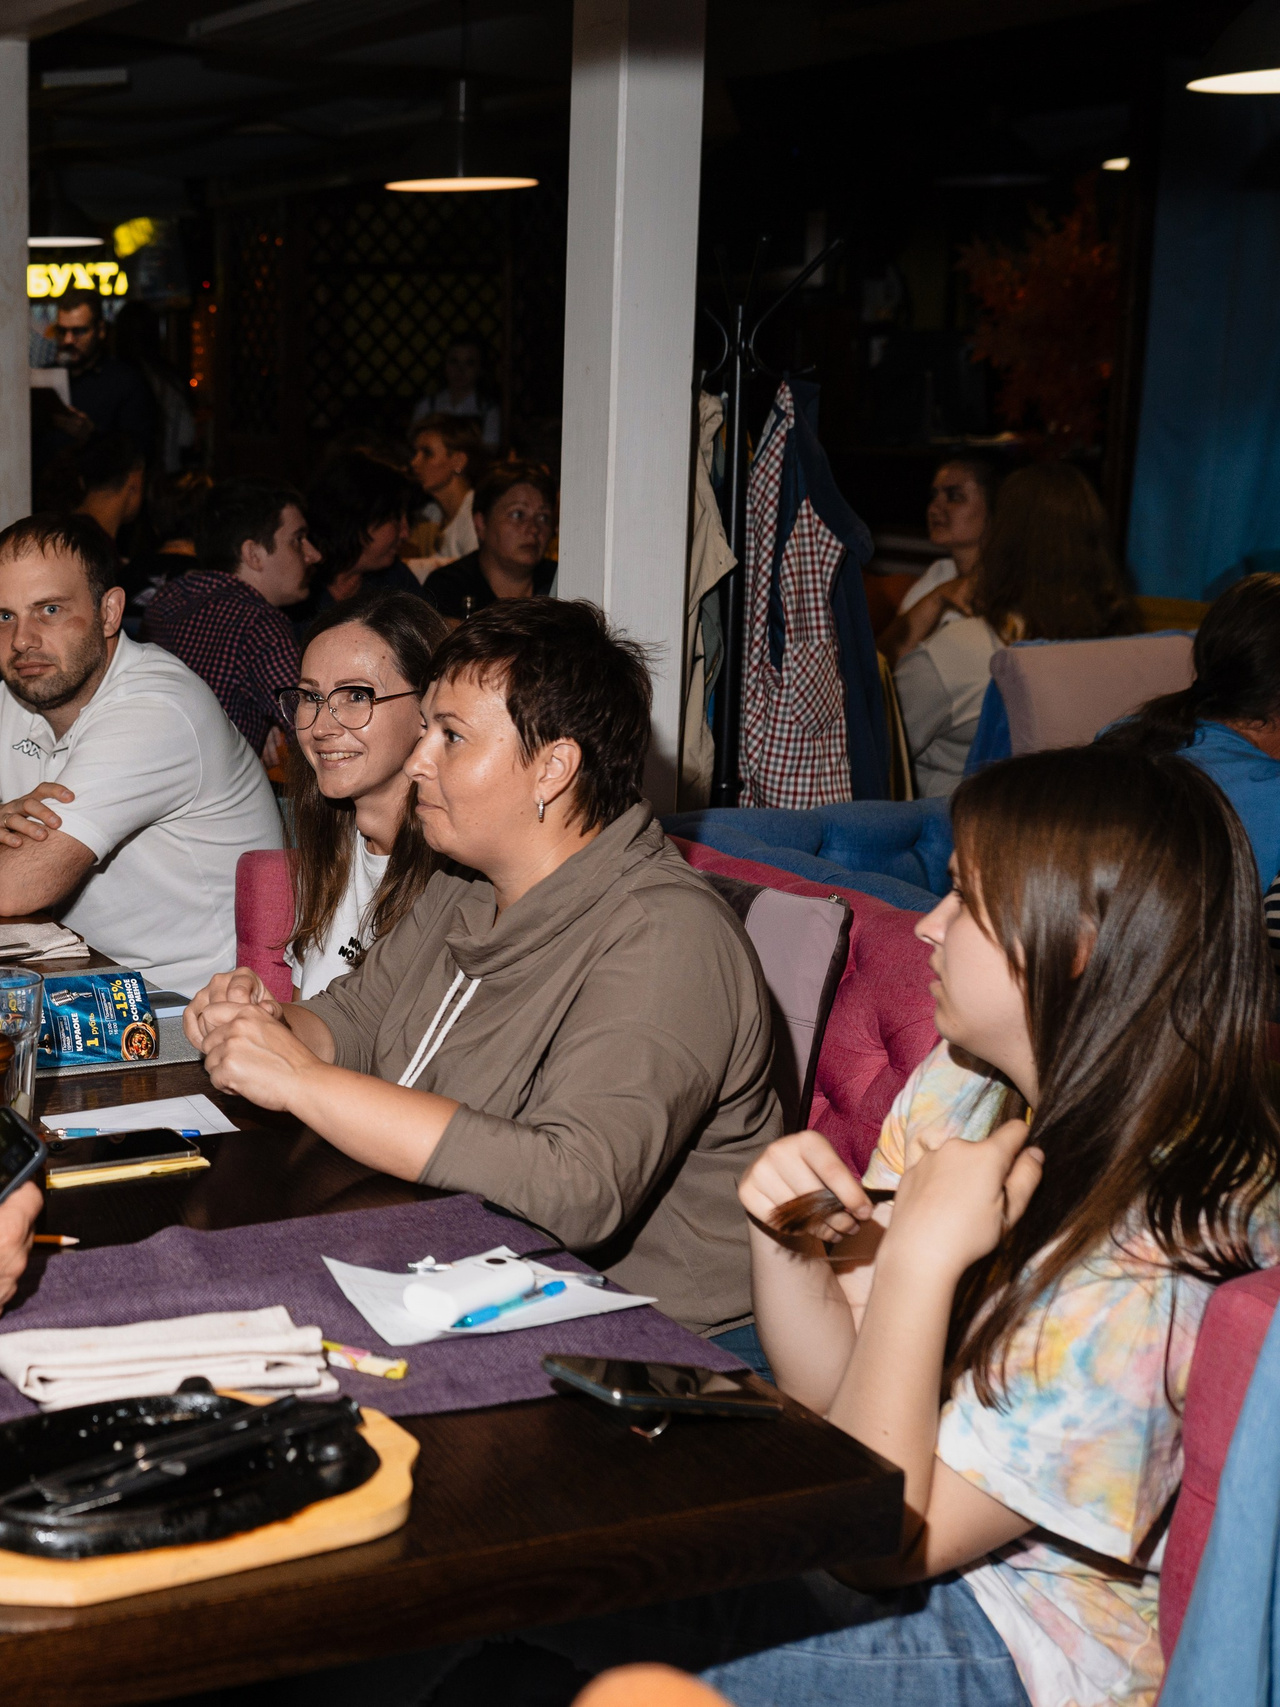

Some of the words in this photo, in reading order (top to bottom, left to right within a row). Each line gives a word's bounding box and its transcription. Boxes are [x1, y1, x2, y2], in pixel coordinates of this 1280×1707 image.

[110, 979, 129, 1018] -15%
[123, 978, 139, 1021] ОСНОВНОЕ
[130, 978, 143, 1003] МЕНЮ
[71, 1012, 83, 1052] КАРАОКЕ
[88, 1012, 99, 1035] рубль
[86, 1037, 99, 1047] 1
